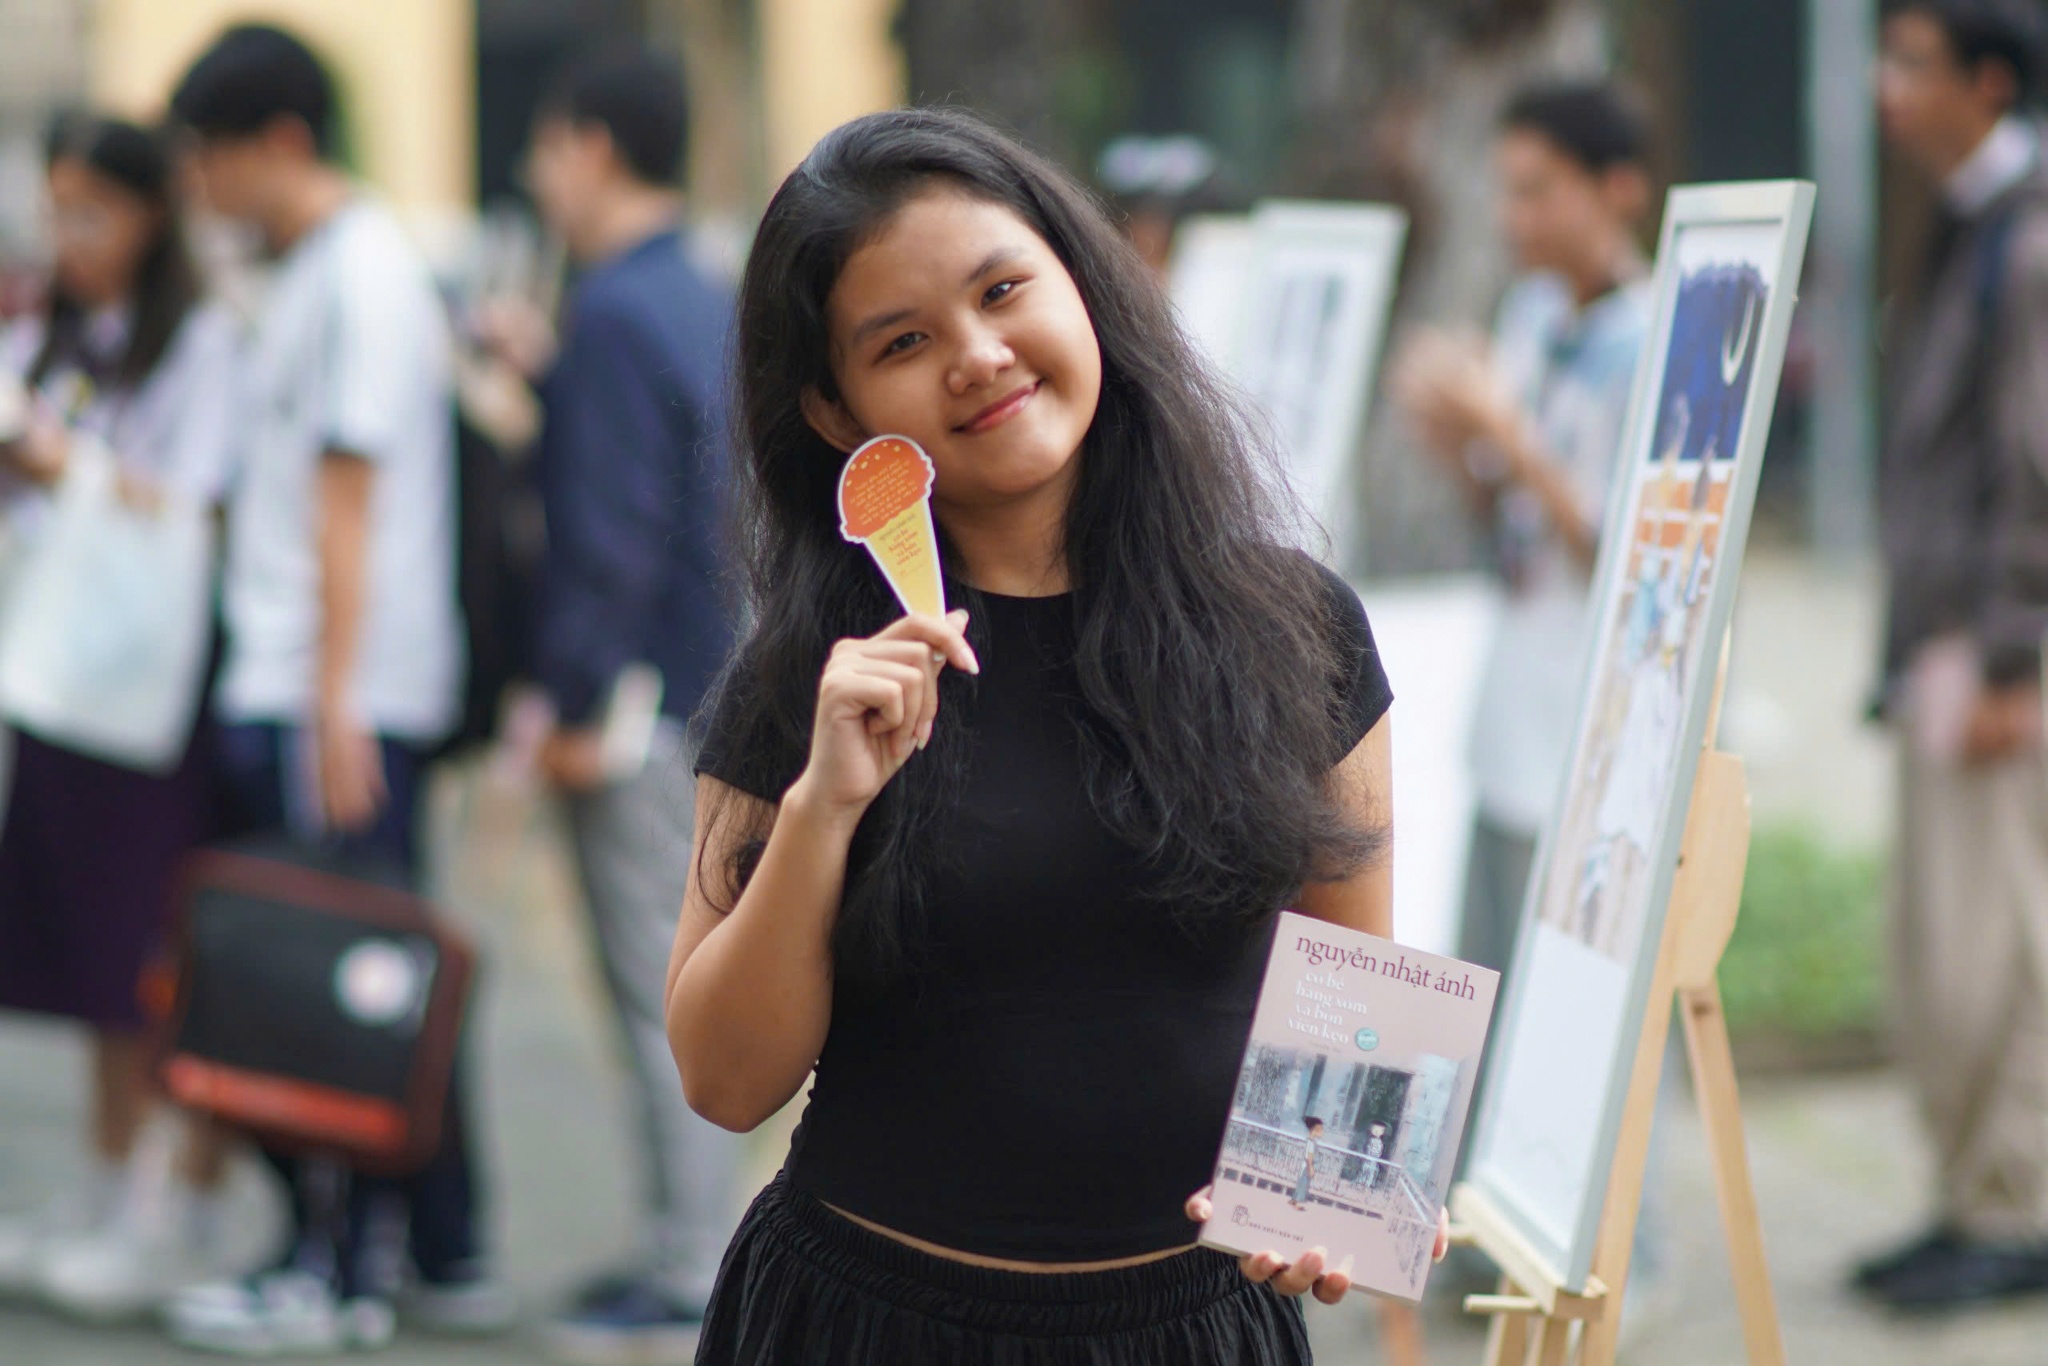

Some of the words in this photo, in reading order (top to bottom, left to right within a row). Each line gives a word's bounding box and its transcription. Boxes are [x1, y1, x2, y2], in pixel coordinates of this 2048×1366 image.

[1296, 937, 1376, 971] nguyễn
[1382, 956, 1431, 988] nhật
[1434, 973, 1476, 1001] ánh
